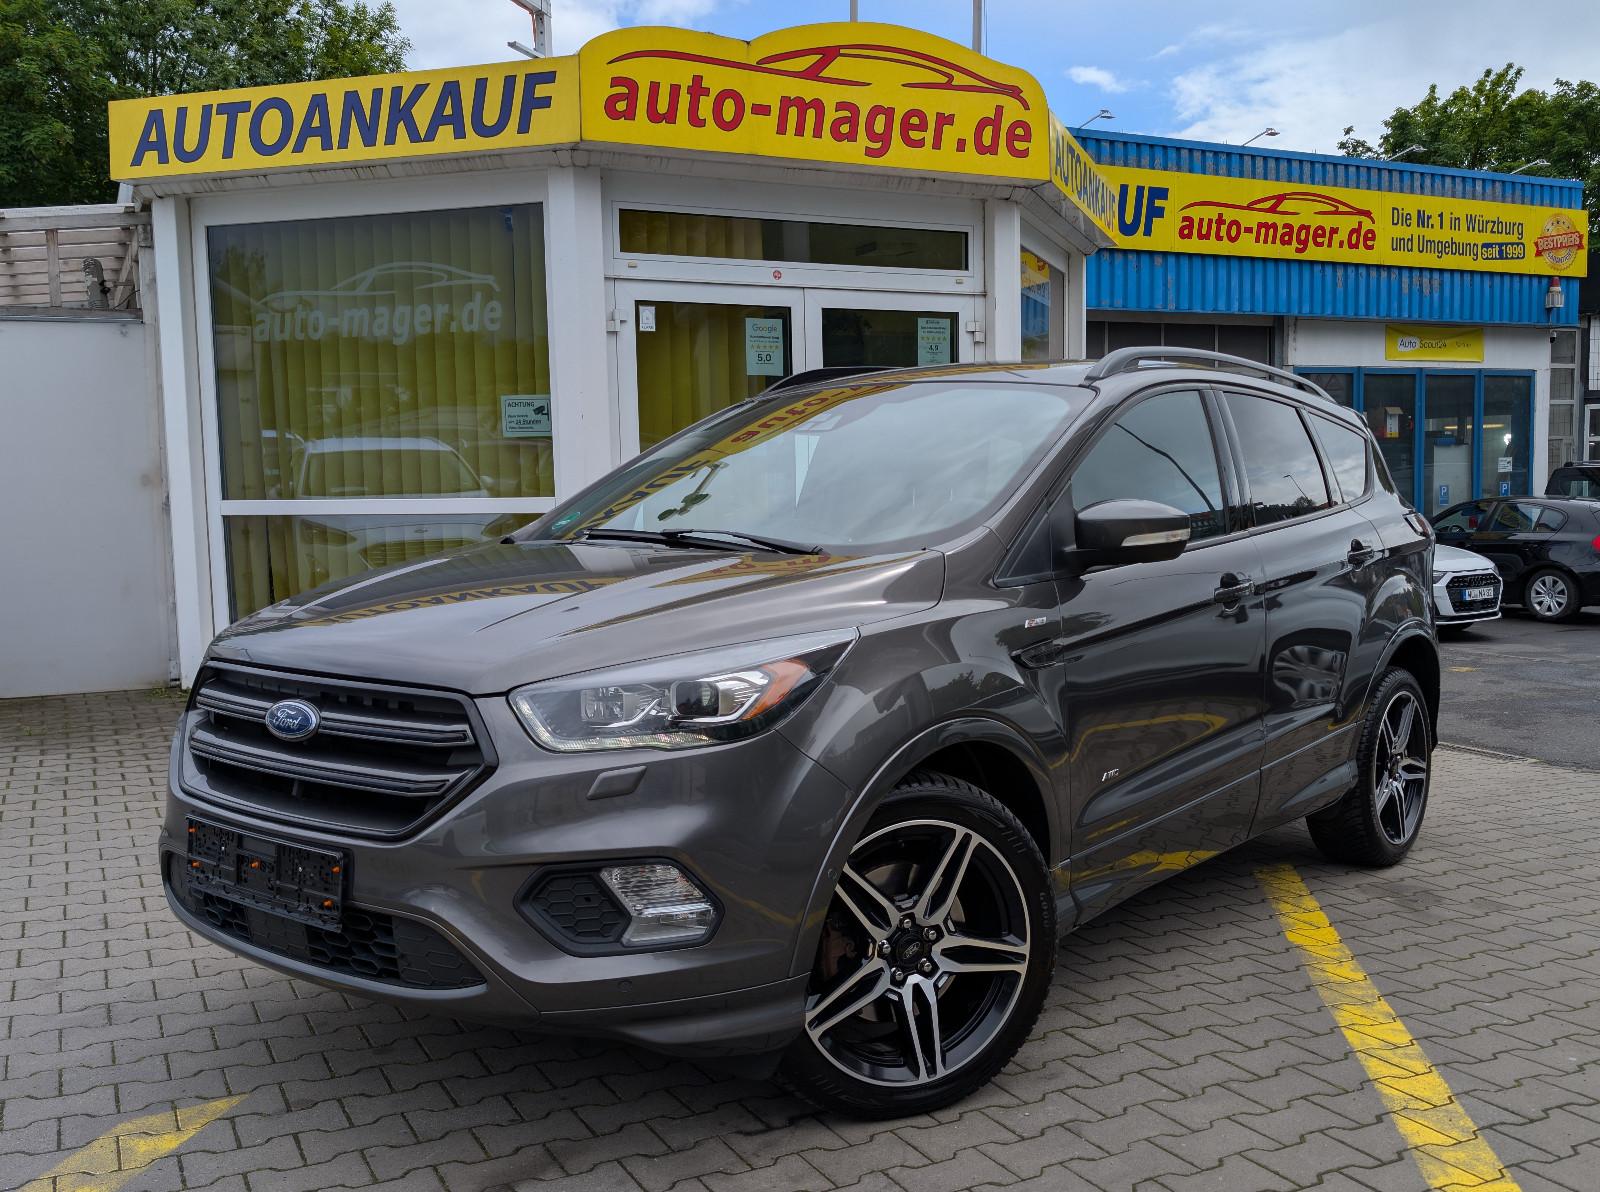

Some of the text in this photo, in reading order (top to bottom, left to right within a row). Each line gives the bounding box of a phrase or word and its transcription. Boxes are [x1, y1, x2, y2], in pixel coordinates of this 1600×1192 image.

[130, 70, 557, 167] AUTOANKAUF
[603, 74, 1033, 158] auto-mager.de
[1055, 134, 1116, 233] AUTOANKAUF
[1178, 212, 1377, 254] auto-mager.de
[1391, 206, 1524, 240] Die Nr. 1 in Würzburg
[1391, 233, 1524, 260] und Umgebung seit 1999
[252, 290, 501, 346] auto-mager.de
[752, 323, 778, 333] Google
[757, 353, 772, 363] 5,0
[1399, 339, 1417, 349] Auto
[273, 708, 302, 729] Ford
